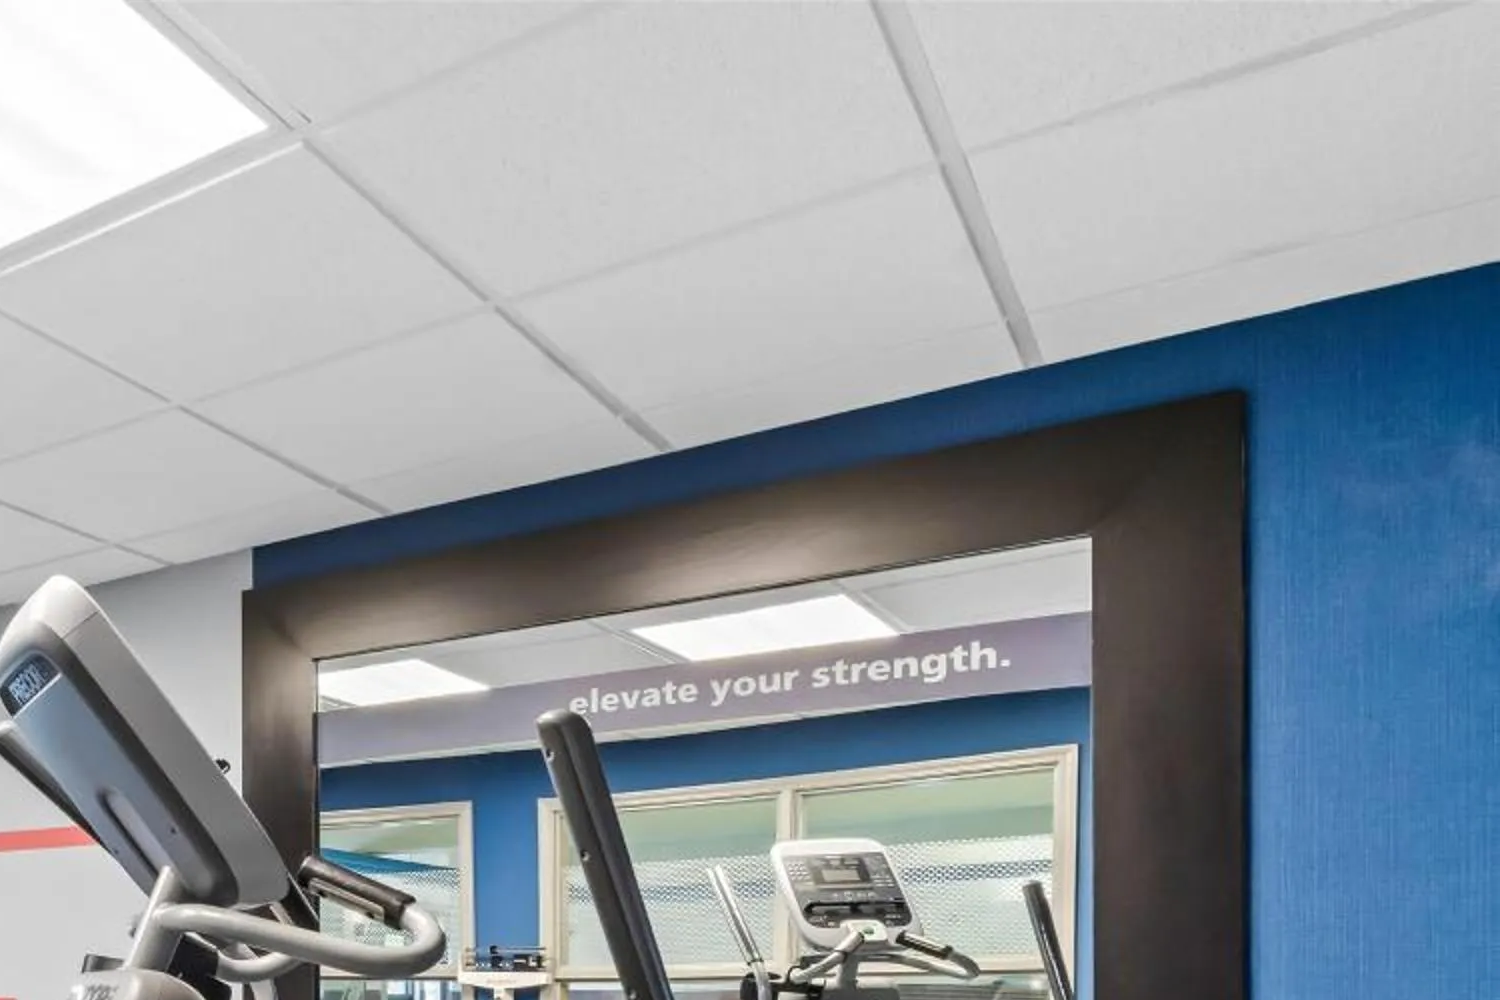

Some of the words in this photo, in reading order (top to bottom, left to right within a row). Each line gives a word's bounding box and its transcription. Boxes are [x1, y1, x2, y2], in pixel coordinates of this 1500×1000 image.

[569, 680, 698, 715] elevate
[710, 669, 800, 707] your
[811, 639, 1011, 689] strength.
